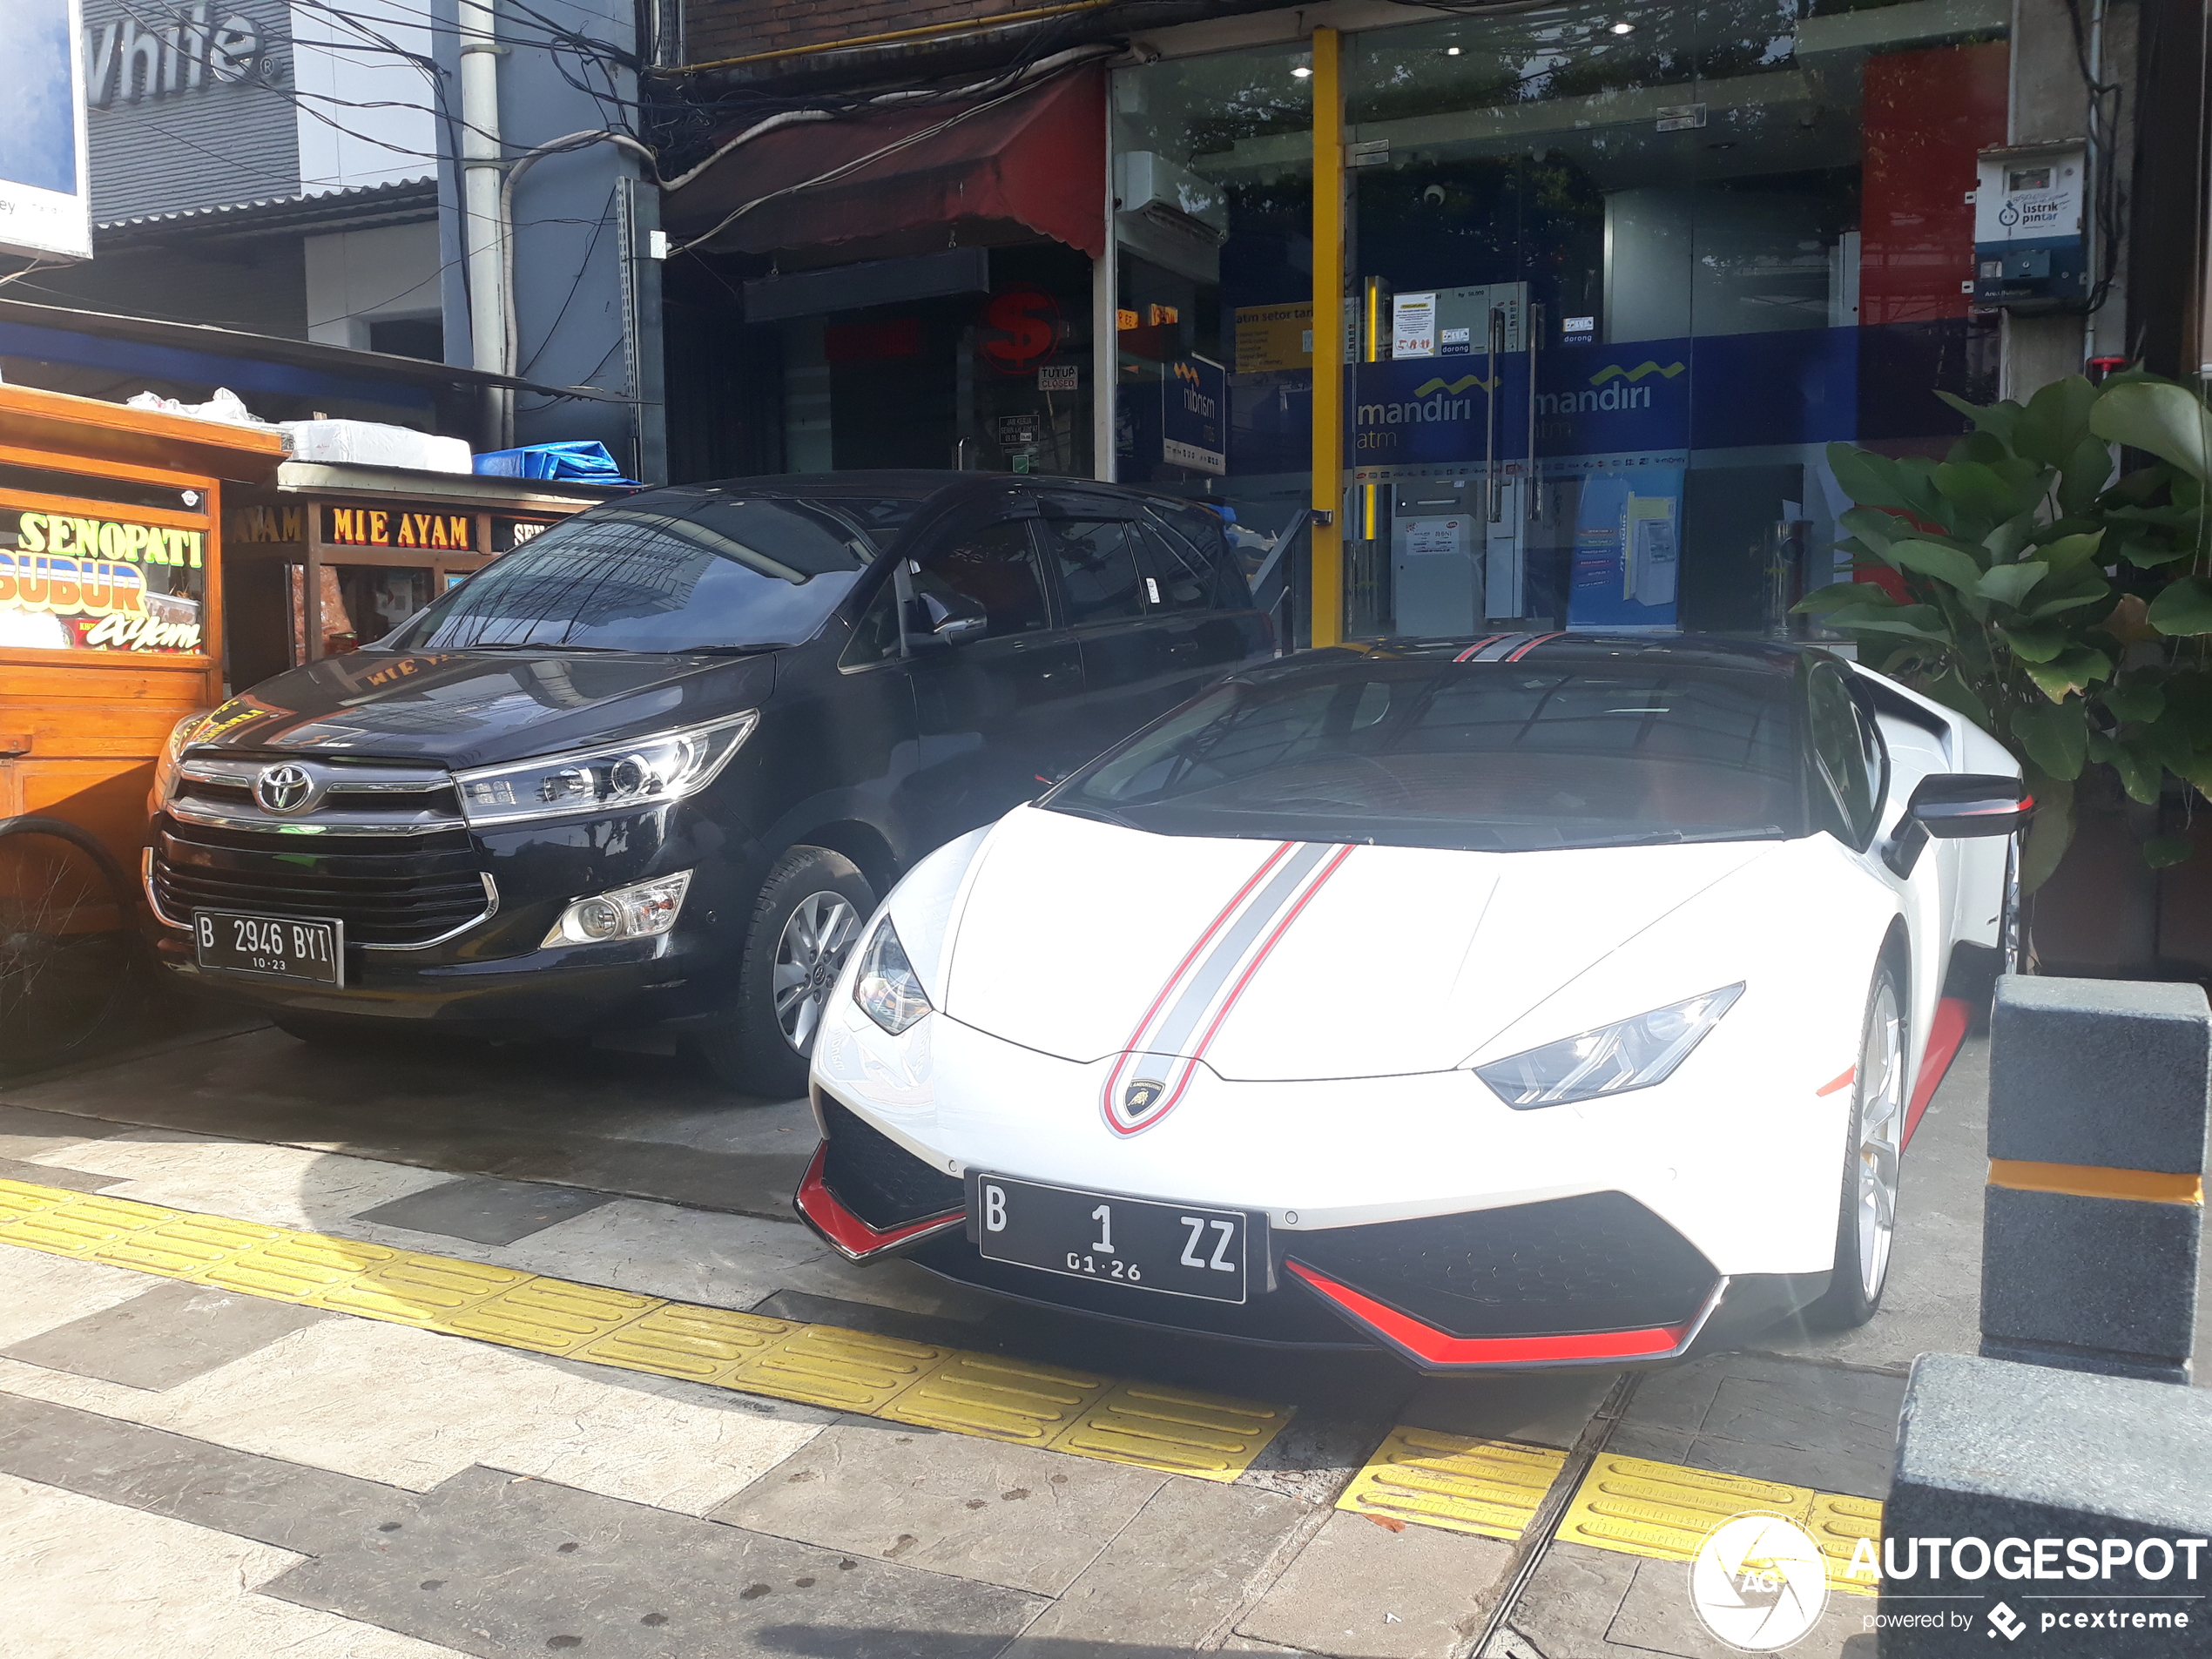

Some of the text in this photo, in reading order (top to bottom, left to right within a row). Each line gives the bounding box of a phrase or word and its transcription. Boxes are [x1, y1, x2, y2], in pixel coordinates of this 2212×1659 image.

[2023, 201, 2059, 214] listrik
[2022, 212, 2059, 226] pintar
[1236, 313, 1259, 324] atm
[1262, 311, 1291, 322] setor
[1564, 334, 1593, 343] dorong
[1041, 368, 1075, 378] TUTUP
[1042, 379, 1075, 388] CLOSED
[1357, 393, 1472, 426] mandiri
[1356, 430, 1398, 449] atm
[332, 507, 471, 551] MIE AYAM
[17, 511, 203, 569] SENOPATI
[199, 915, 328, 962] B 2946 BYI
[985, 1184, 1236, 1273] B 1 ZZ
